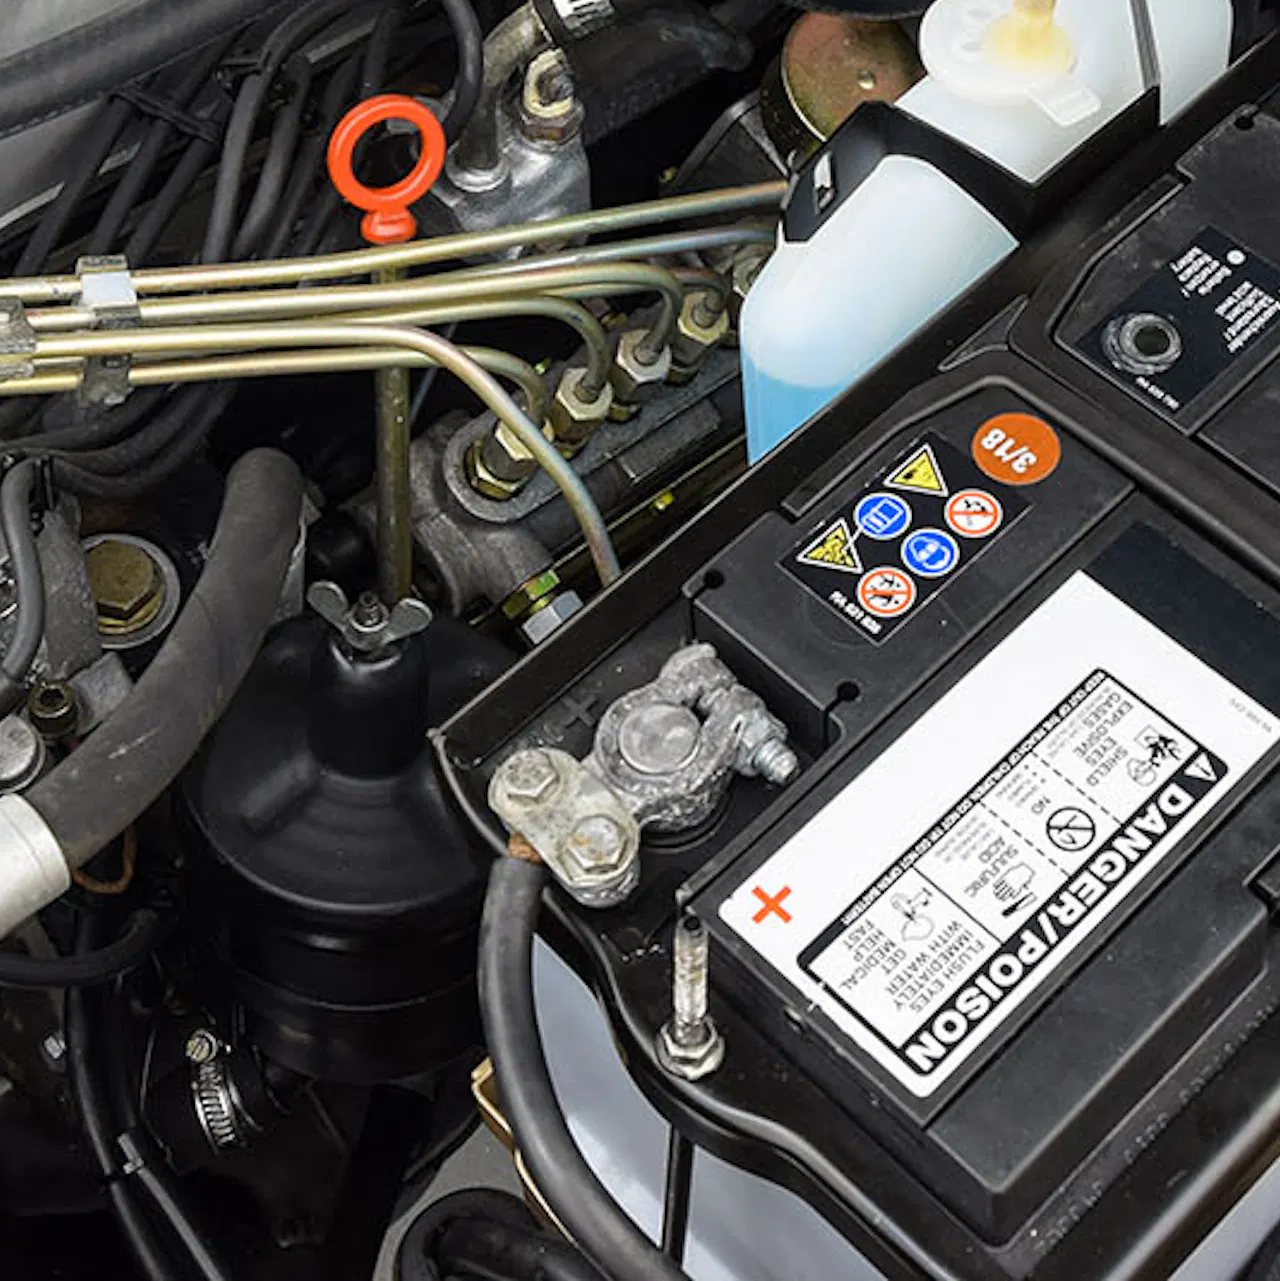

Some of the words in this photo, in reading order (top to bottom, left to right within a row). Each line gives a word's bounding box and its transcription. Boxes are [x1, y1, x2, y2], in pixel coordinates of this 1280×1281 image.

[980, 427, 1038, 474] 3/18
[1070, 698, 1134, 759] EXPLOSIVE
[1079, 689, 1123, 730] GASES
[1082, 734, 1118, 768] EYES
[1083, 744, 1130, 788] SHIELD
[961, 843, 1020, 899] SULFURIC
[975, 834, 1009, 866] ACID
[838, 917, 876, 952] FAST
[848, 927, 887, 964] HELP
[925, 917, 964, 955] WITH
[836, 936, 897, 994] MEDICAL
[877, 945, 908, 975] GET
[882, 949, 932, 997] WATER
[888, 926, 975, 1012] IMMEDIATELY
[939, 936, 986, 982] FLUSH
[907, 976, 946, 1014] EYES
